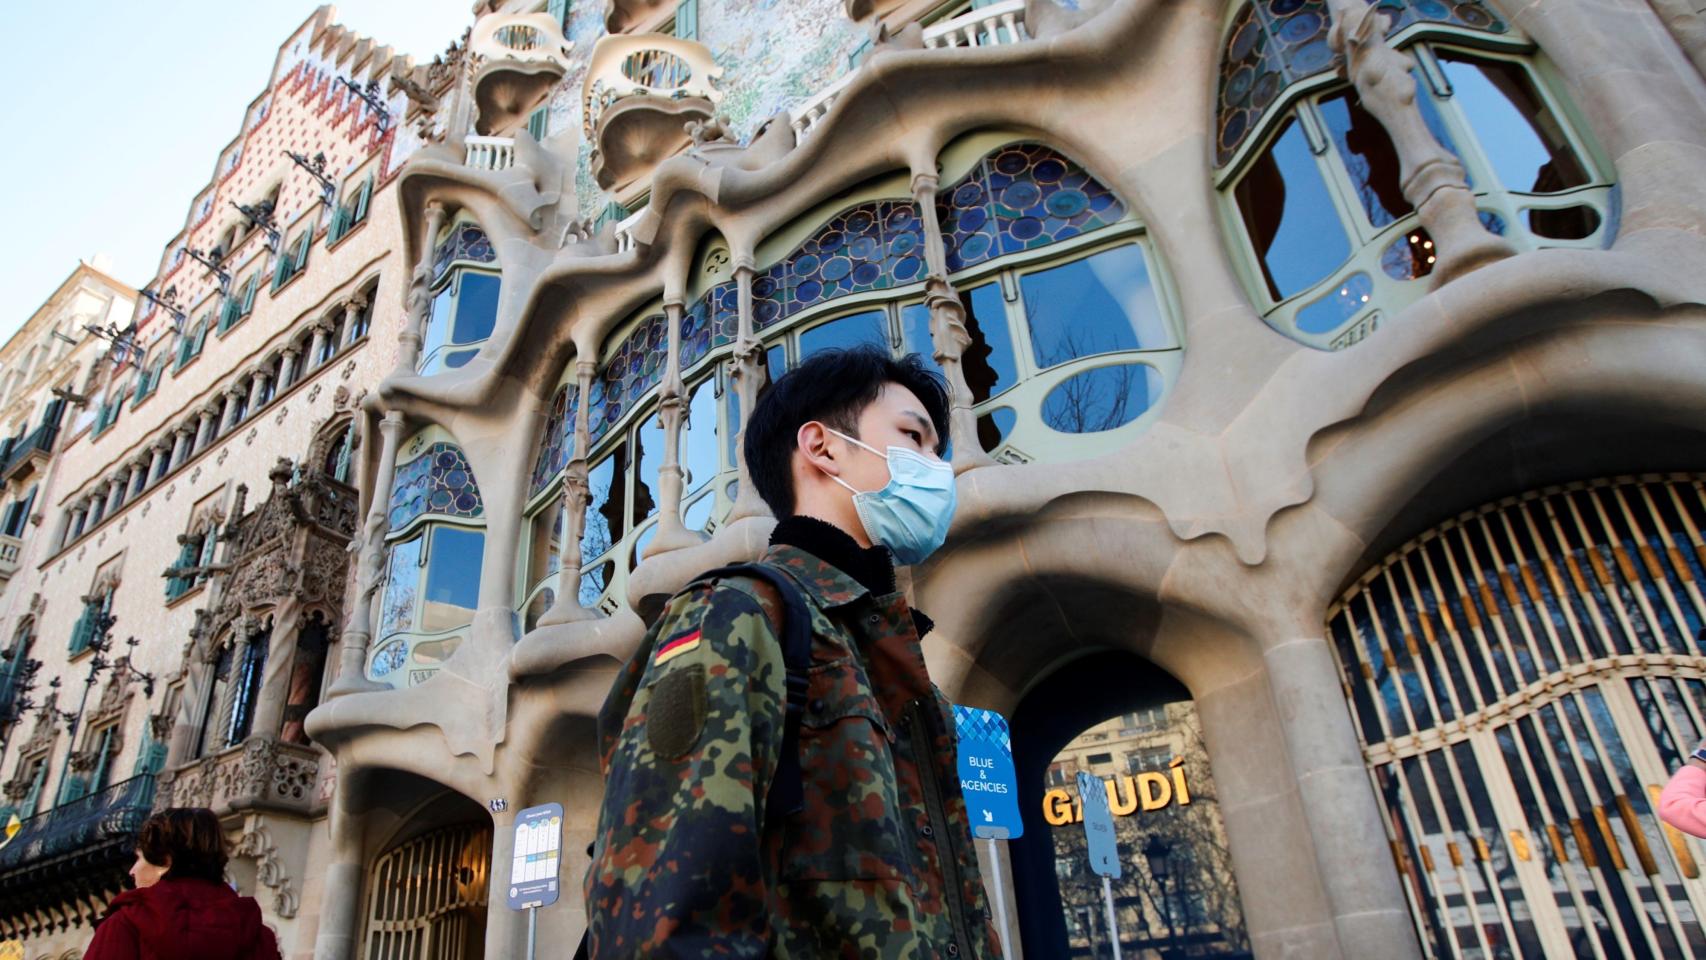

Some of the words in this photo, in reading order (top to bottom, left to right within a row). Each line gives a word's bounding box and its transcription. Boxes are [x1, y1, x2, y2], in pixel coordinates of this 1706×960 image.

[968, 756, 994, 769] BLUE
[979, 769, 987, 780] &
[961, 780, 1008, 794] AGENCIES
[1043, 756, 1190, 826] GUDÍ
